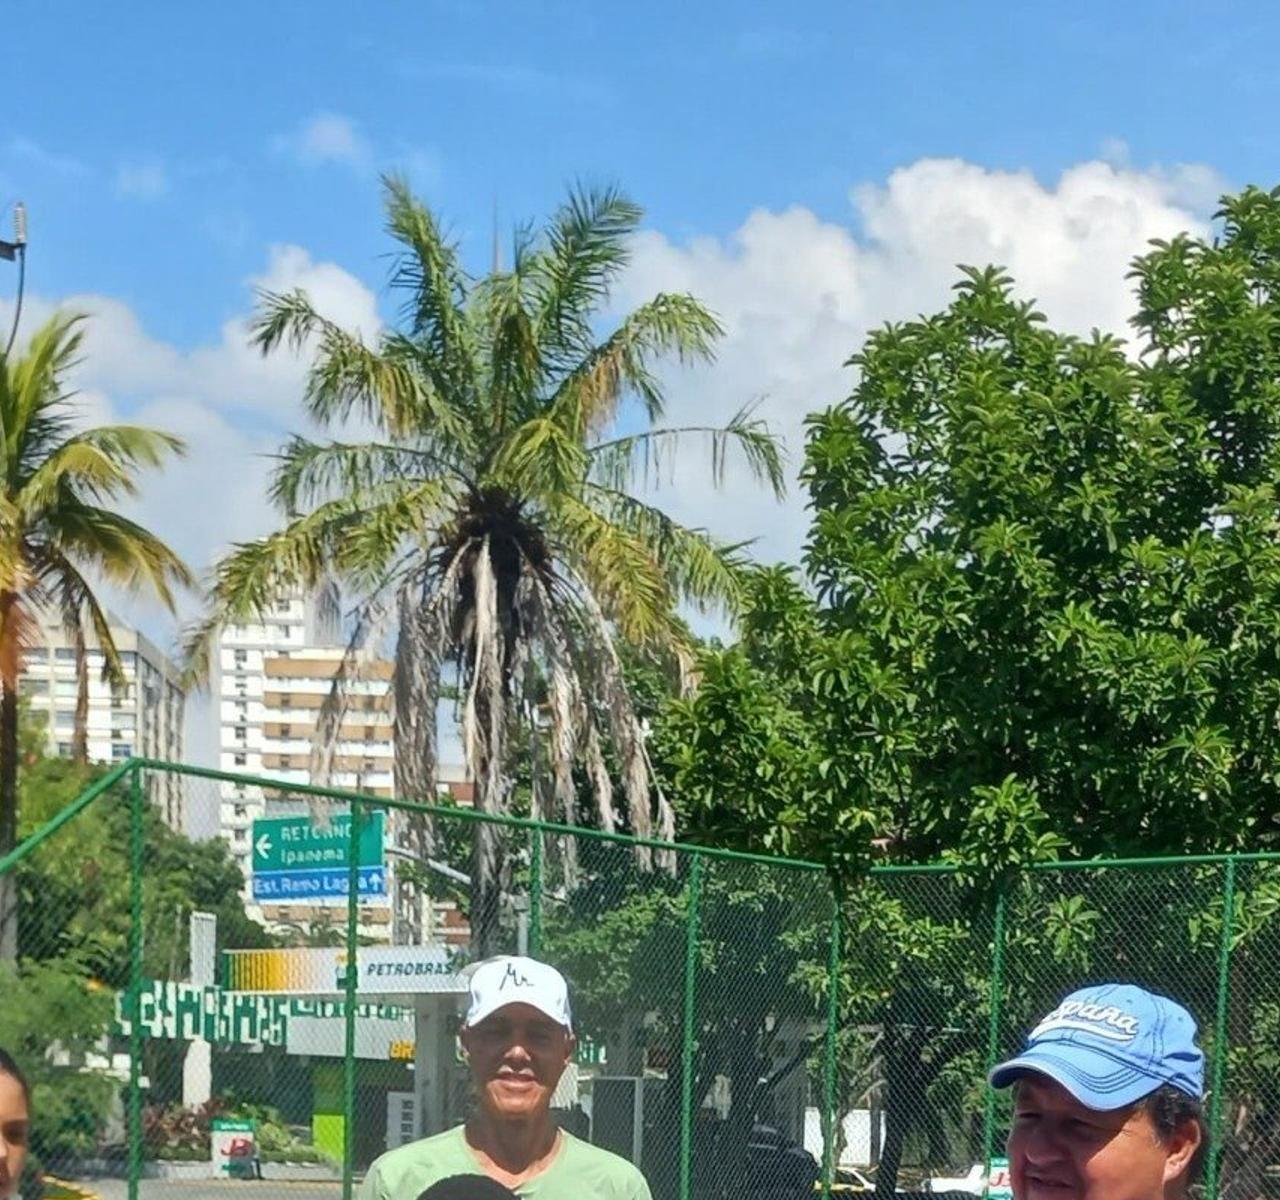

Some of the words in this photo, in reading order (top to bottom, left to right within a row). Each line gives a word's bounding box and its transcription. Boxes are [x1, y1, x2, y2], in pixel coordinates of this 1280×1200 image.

[281, 849, 344, 865] Ipanema
[323, 875, 367, 893] Laga
[367, 962, 453, 976] PETROBRAS
